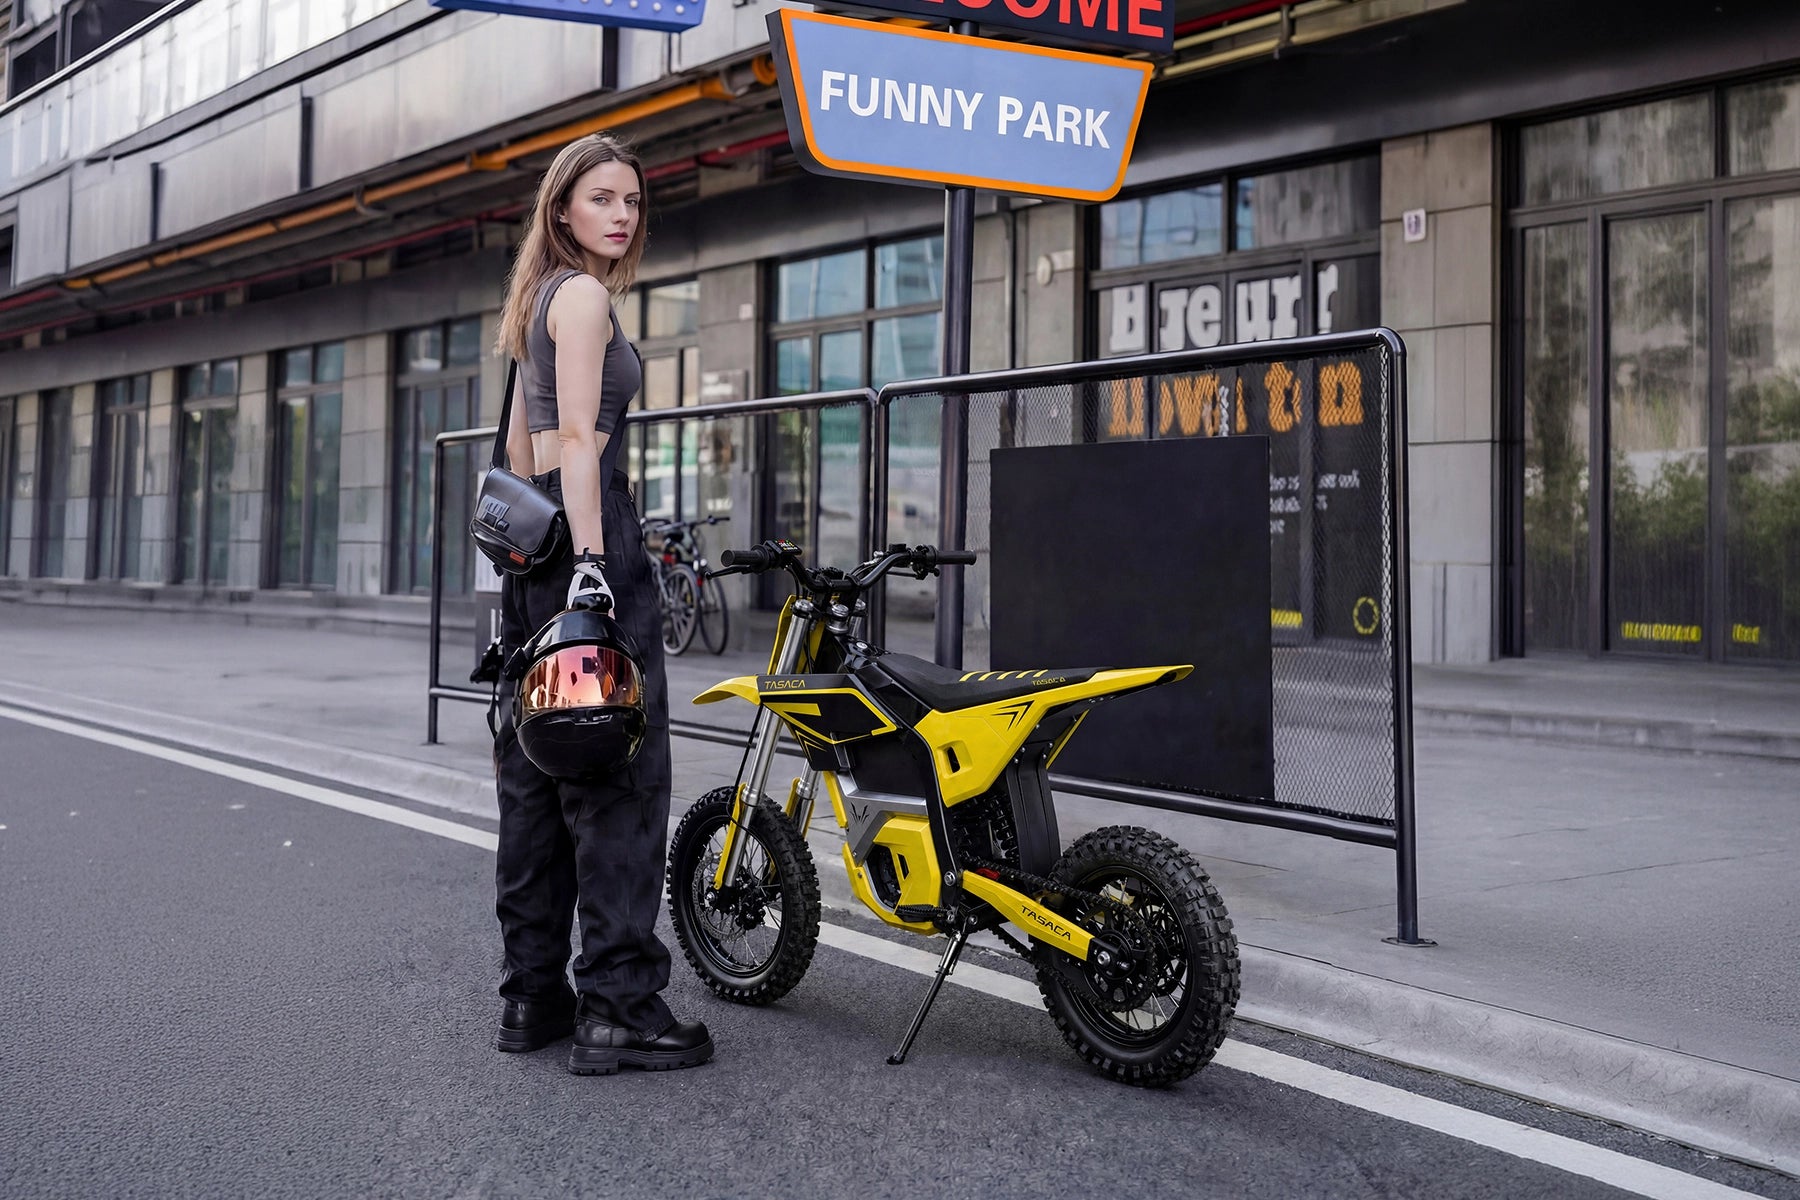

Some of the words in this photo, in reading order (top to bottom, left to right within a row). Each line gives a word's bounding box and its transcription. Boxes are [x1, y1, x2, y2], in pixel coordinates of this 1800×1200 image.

[820, 70, 984, 131] FUNNY
[997, 95, 1111, 149] PARK
[764, 679, 806, 689] TASACA
[1021, 904, 1072, 941] TASACA
